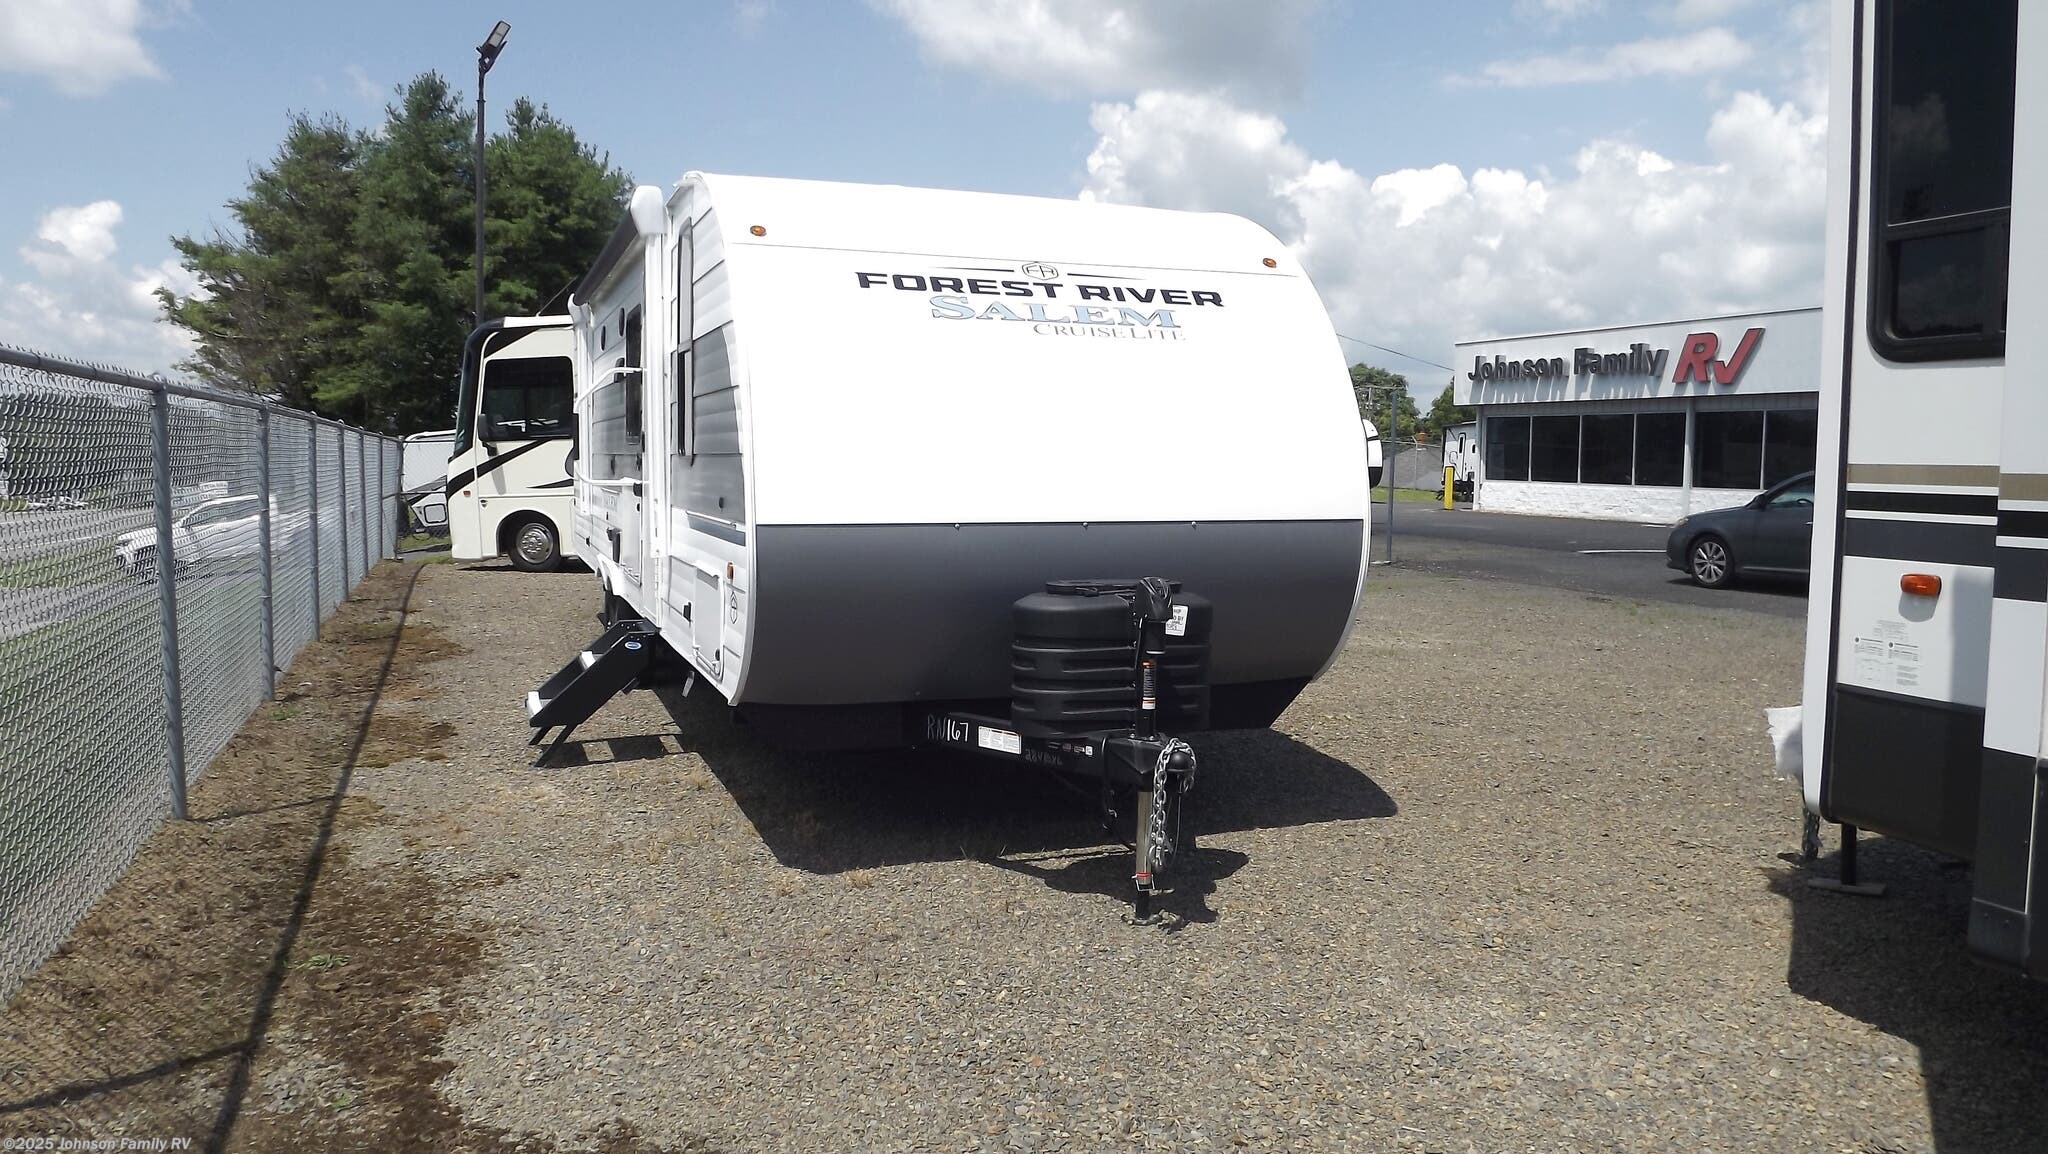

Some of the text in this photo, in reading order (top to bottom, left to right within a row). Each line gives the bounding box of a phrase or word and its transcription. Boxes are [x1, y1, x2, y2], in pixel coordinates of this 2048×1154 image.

[855, 272, 1224, 307] FOREST RIVER
[1467, 328, 1765, 384] Johnson Family RV
[927, 714, 969, 742] RN167
